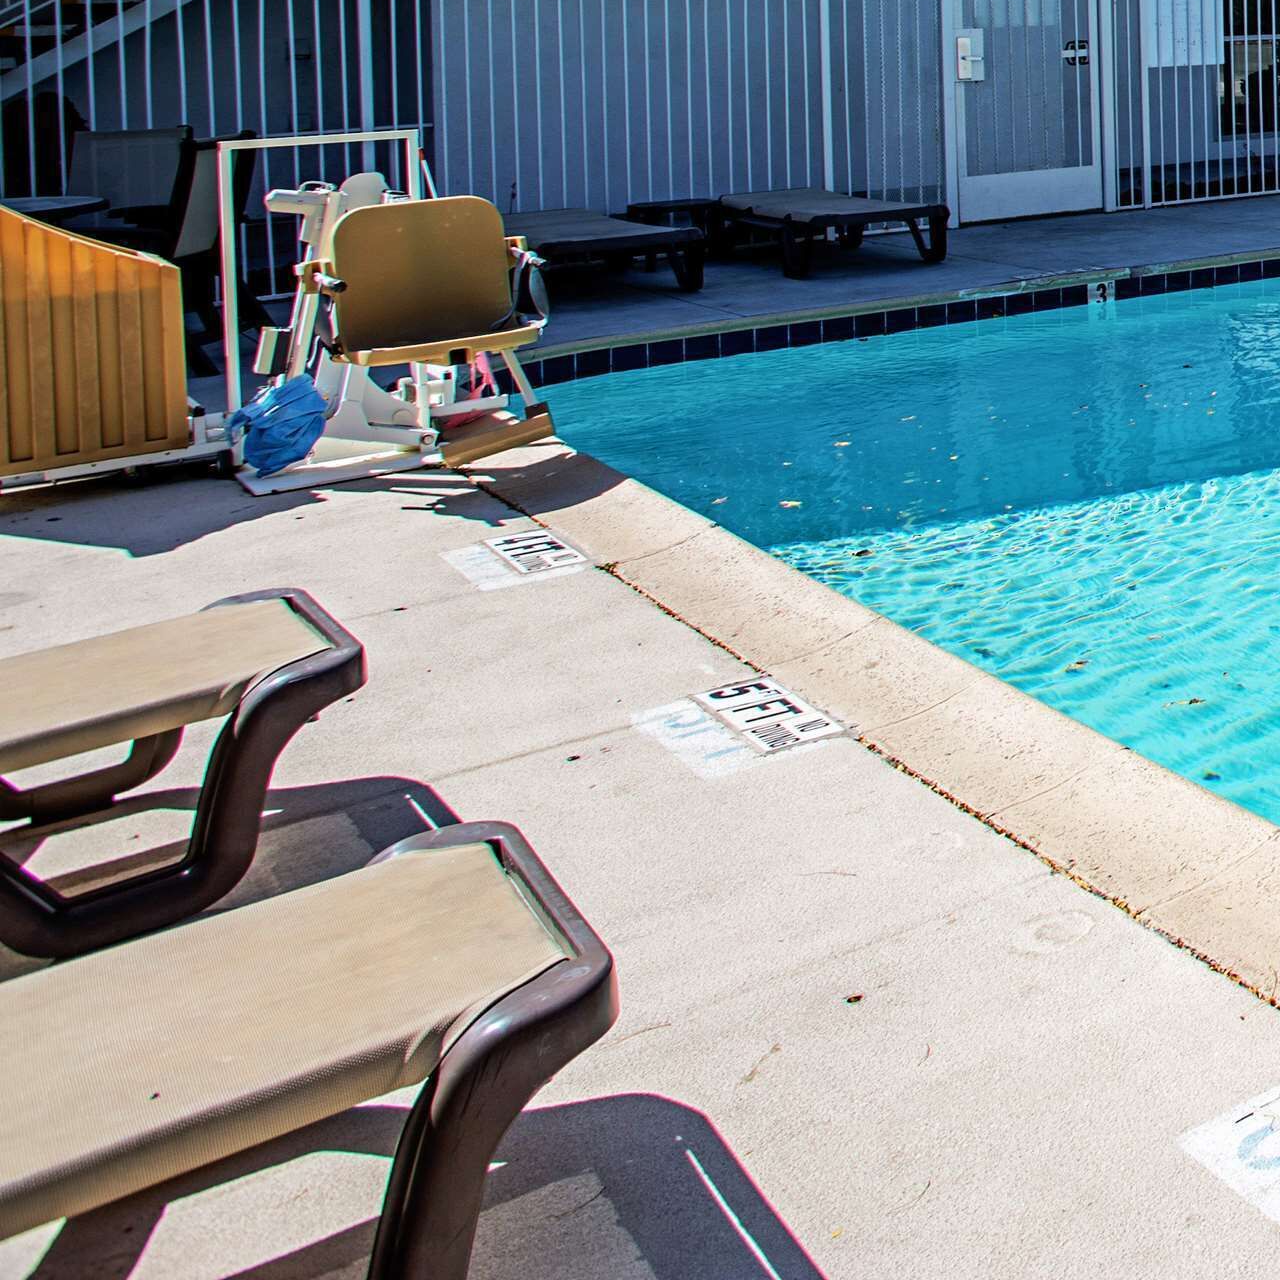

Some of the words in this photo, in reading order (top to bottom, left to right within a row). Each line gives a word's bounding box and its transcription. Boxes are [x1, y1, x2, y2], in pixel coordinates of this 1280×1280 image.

[1096, 283, 1107, 303] 3
[709, 682, 770, 700] 5
[732, 697, 804, 723] FT
